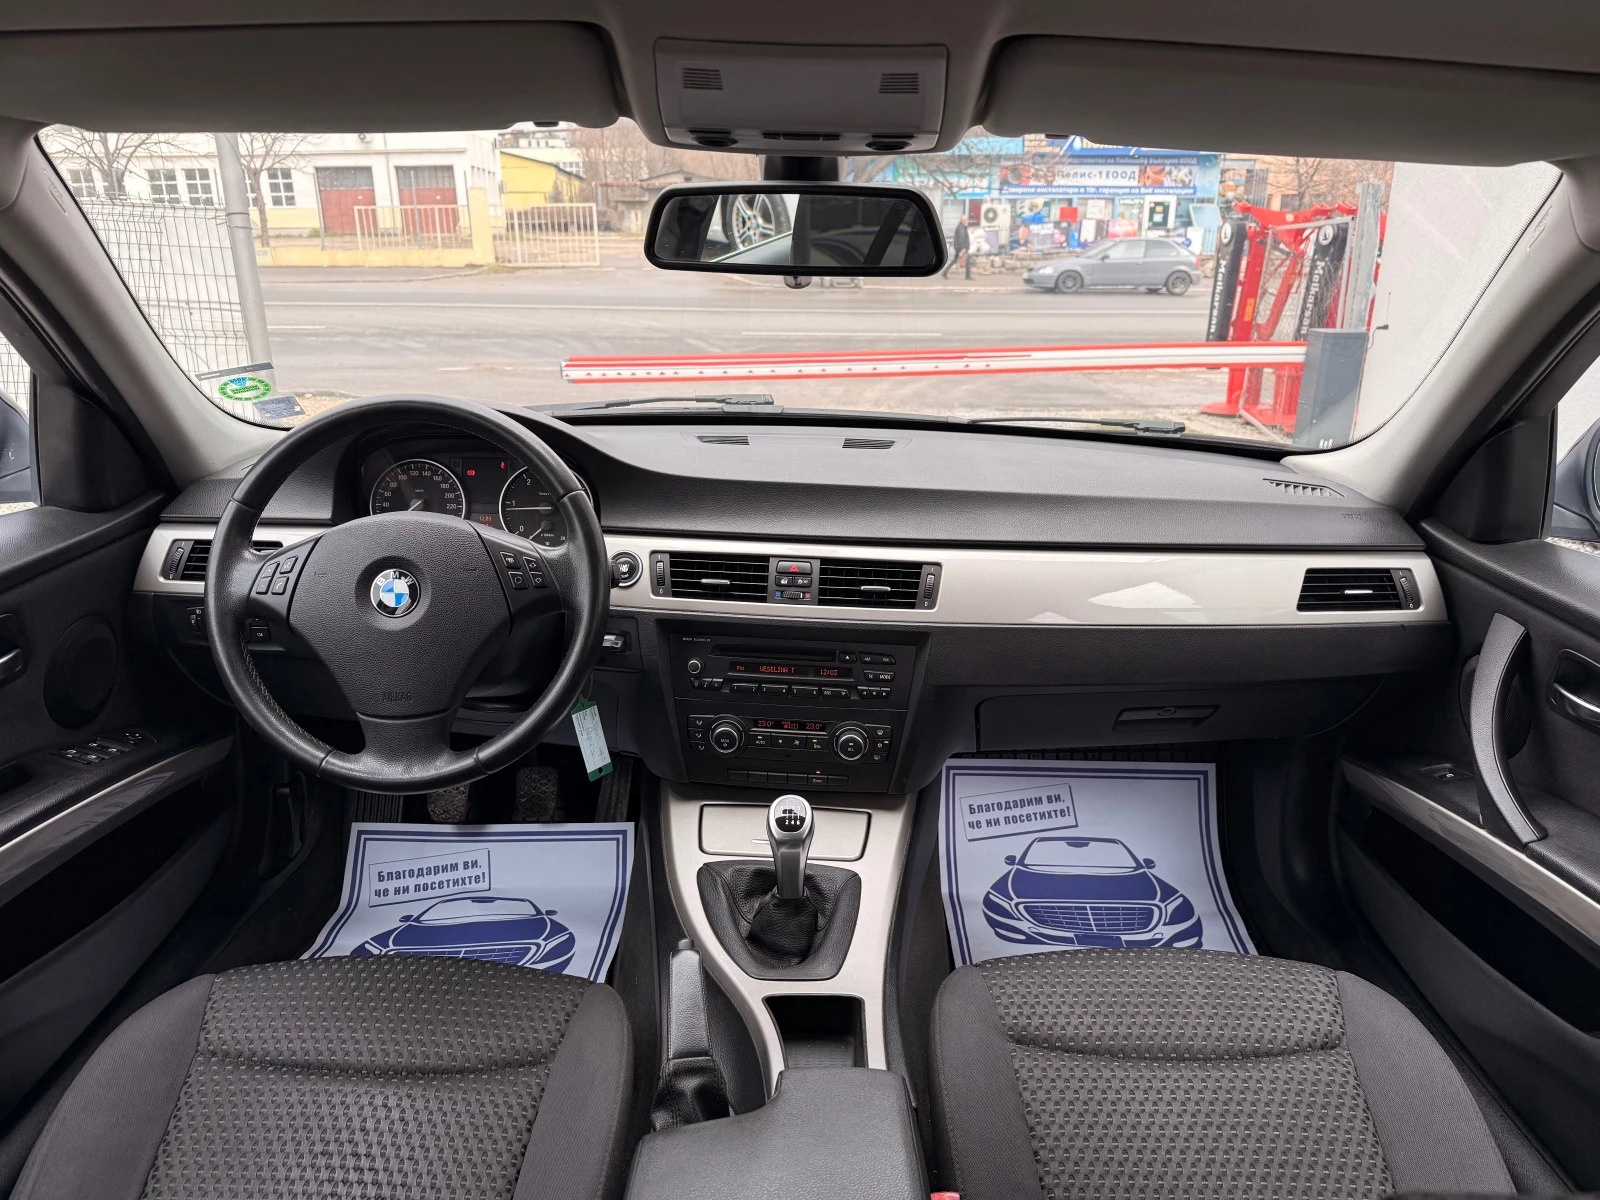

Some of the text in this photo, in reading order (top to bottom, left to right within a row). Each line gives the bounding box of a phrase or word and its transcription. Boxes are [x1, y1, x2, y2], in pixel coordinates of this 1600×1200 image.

[1105, 171, 1137, 180] ЕООД
[1210, 258, 1228, 333] Melkarsan
[1300, 259, 1325, 334] Melkarsan
[526, 478, 531, 486] 2
[376, 571, 415, 587] BMW
[968, 793, 1065, 815] Благодарим ви,
[968, 806, 1071, 830] че ни посетихте!
[377, 859, 482, 883] Благодарим ви,
[374, 872, 486, 898] че ни посетихте!
